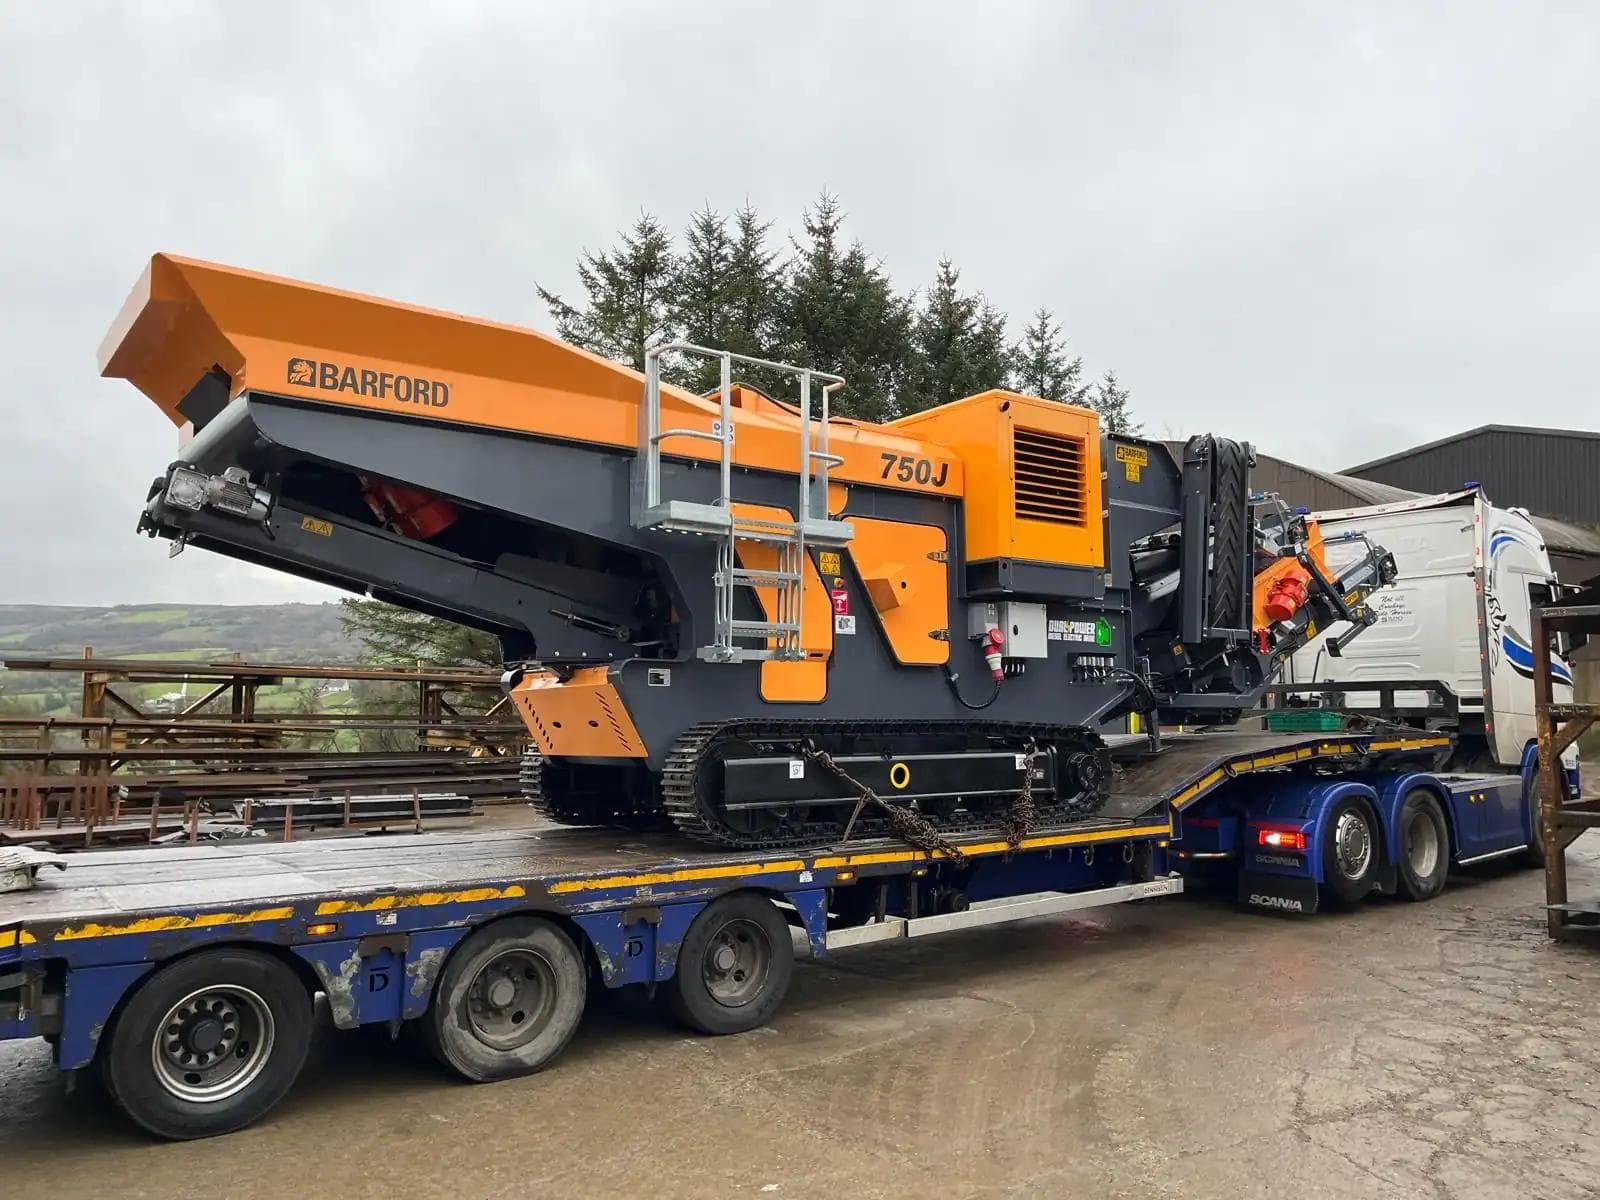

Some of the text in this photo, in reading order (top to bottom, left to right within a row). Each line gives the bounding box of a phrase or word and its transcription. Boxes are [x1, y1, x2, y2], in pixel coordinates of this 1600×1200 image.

[319, 362, 449, 408] BARFORD
[880, 453, 949, 488] 750J
[1255, 855, 1300, 867] SCANIA
[1248, 893, 1303, 913] SCANIA
